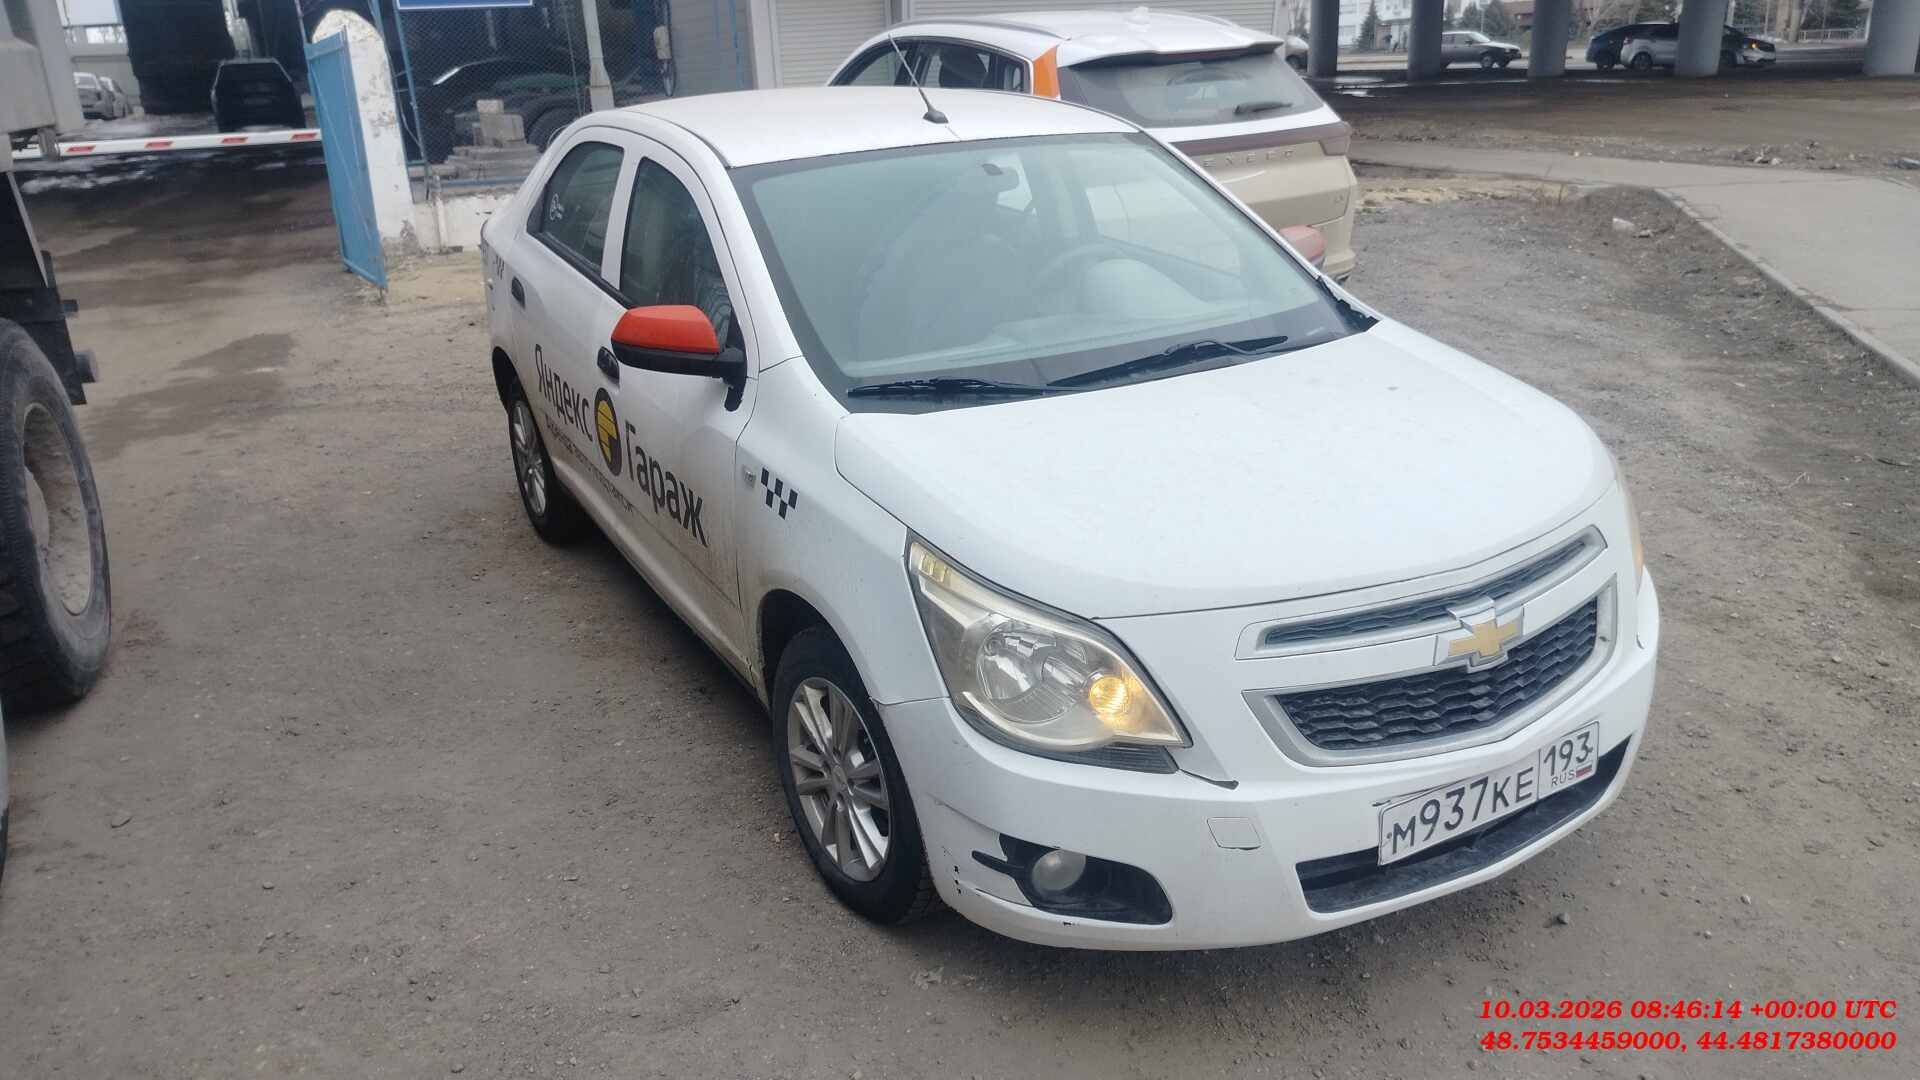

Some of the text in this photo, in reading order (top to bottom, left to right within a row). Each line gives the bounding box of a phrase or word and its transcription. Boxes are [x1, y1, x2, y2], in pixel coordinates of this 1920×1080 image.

[534, 343, 594, 443] Яндекс
[625, 419, 710, 549] Гараж
[1543, 730, 1592, 776] 193
[1551, 769, 1576, 788] RUS
